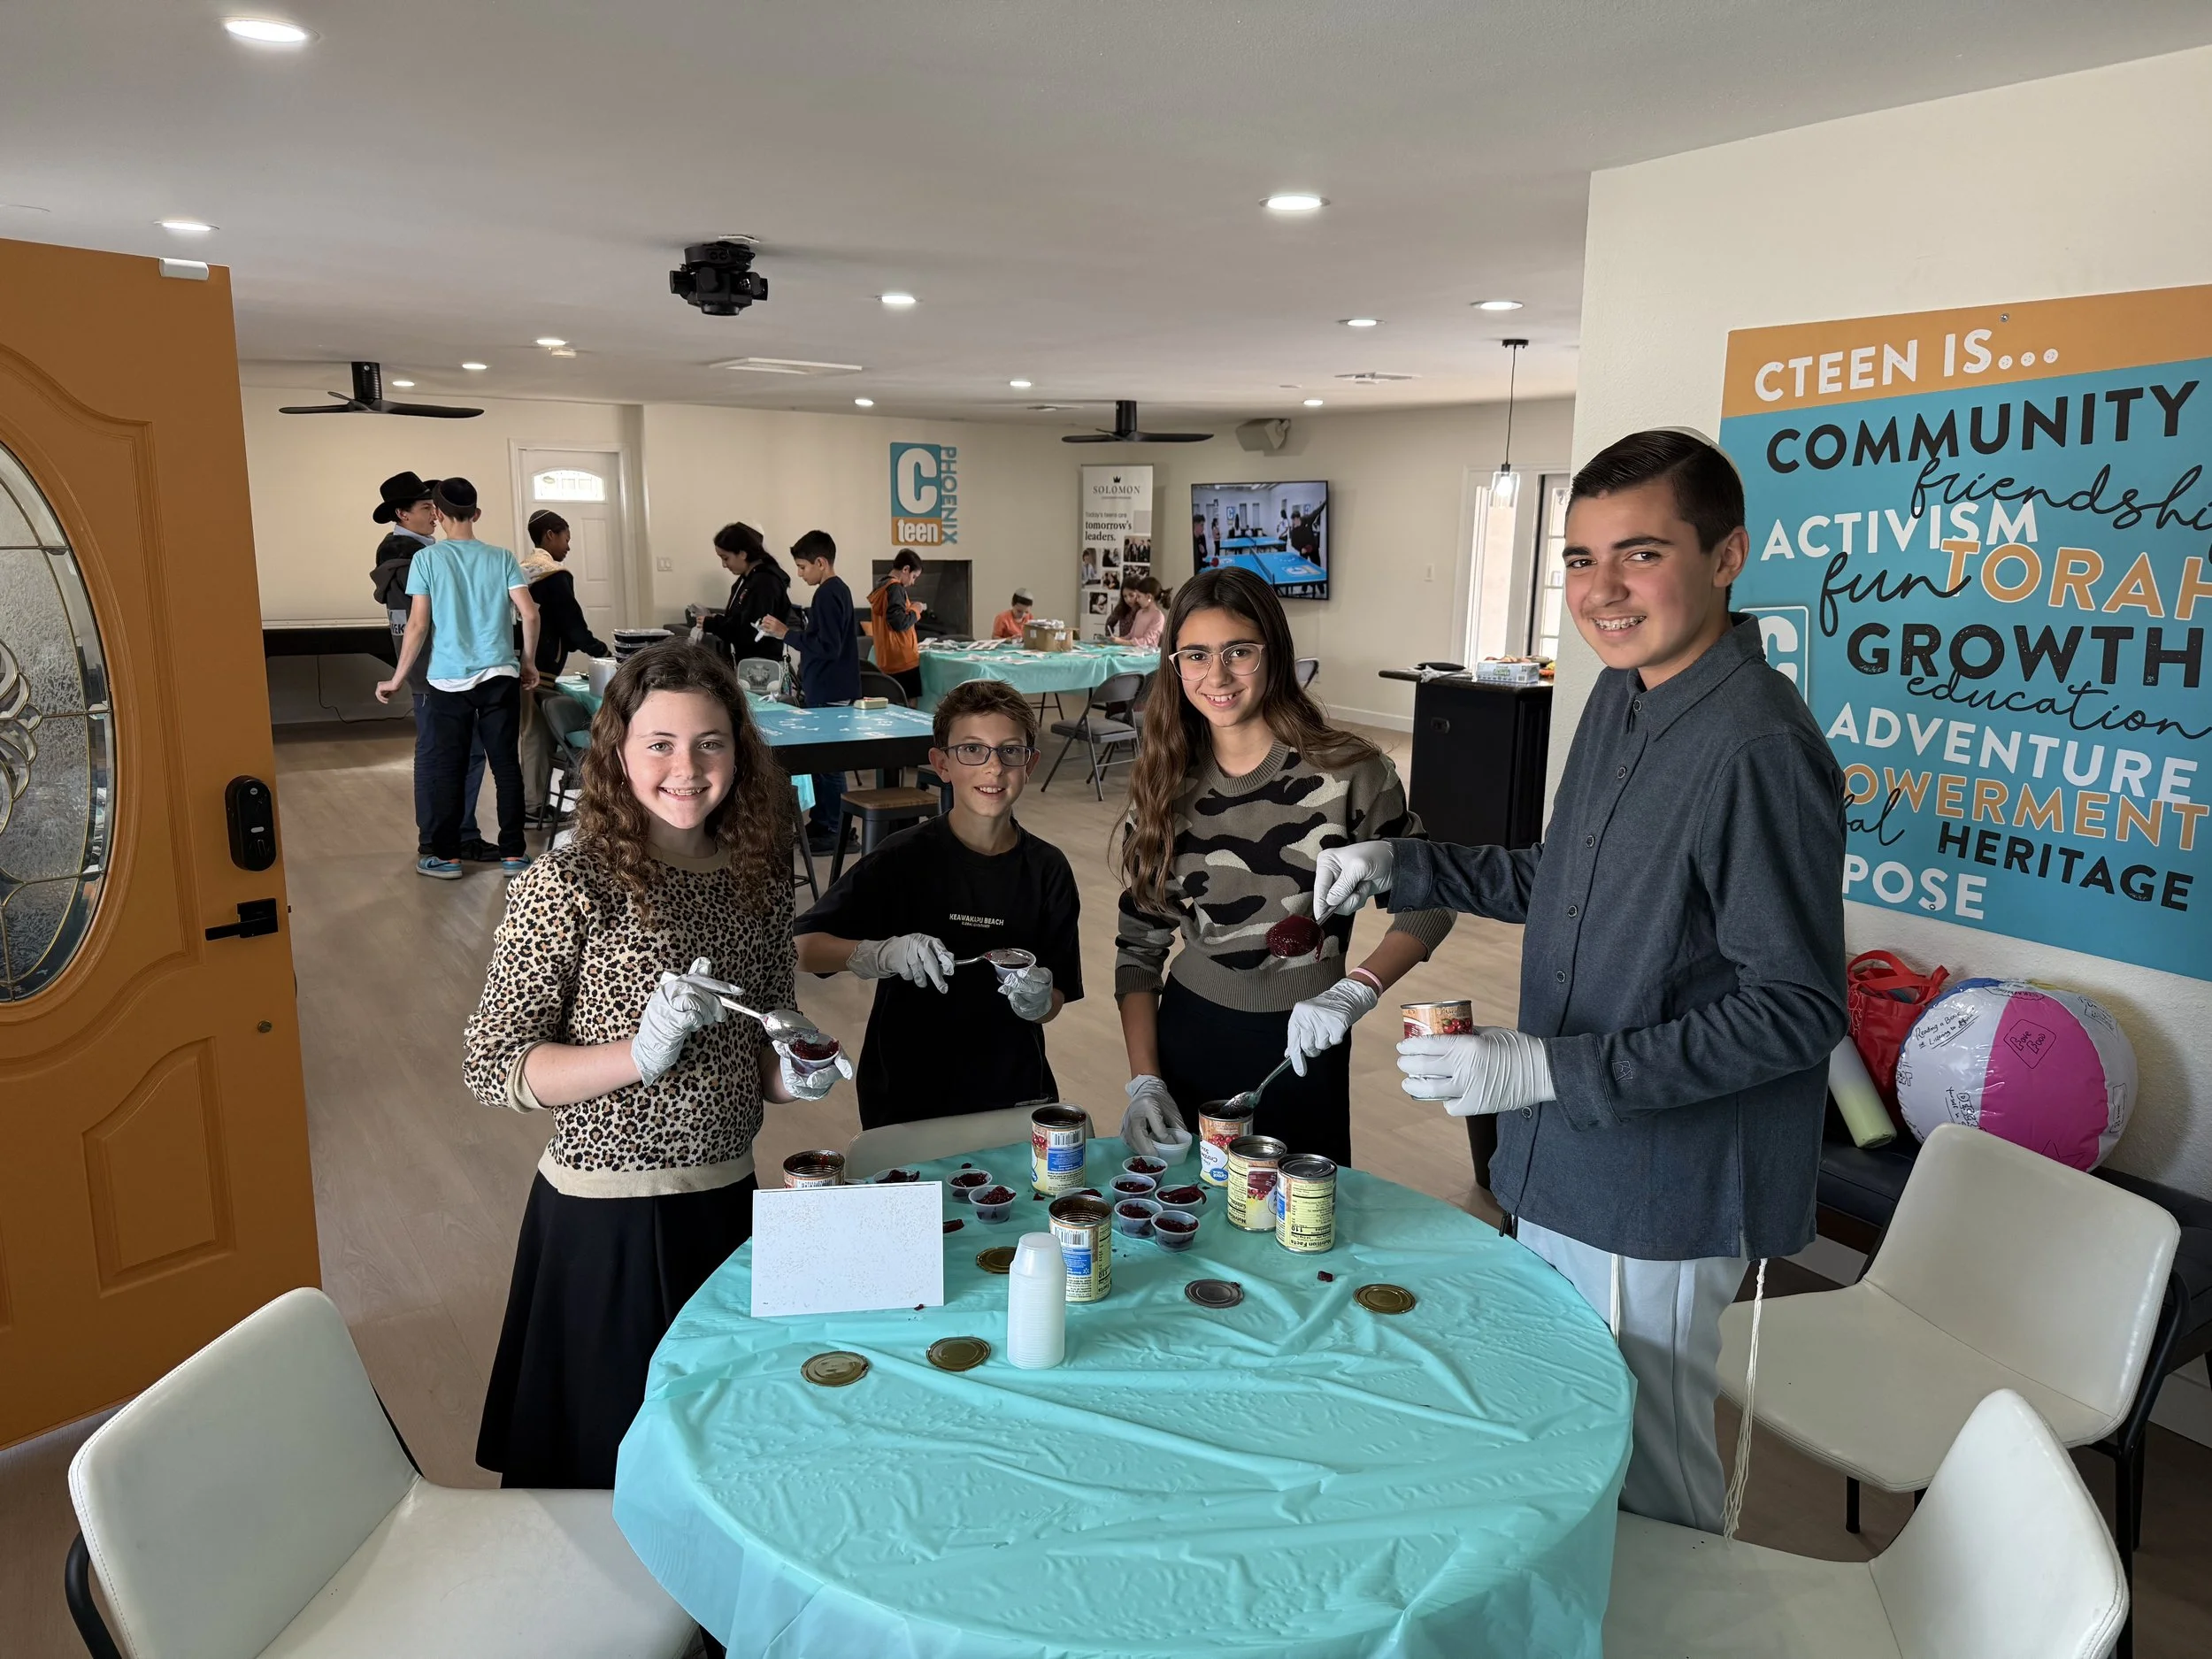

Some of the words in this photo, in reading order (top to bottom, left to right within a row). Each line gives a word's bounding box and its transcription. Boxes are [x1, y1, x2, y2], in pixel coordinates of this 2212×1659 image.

[1755, 339, 1917, 402] CTEEN
[1944, 329, 2059, 377] IS...
[1766, 380, 2200, 473] COMMUNITY
[897, 448, 938, 514] C
[941, 446, 957, 544] PHOENIX
[1093, 486, 1141, 495] SOLOMON
[1911, 457, 2212, 565] friendshi
[897, 518, 939, 543] teen
[1085, 520, 1132, 530] tomorrow's
[1085, 531, 1116, 541] leaders.
[1761, 498, 2039, 561] ACTIVISM
[1819, 551, 1971, 637] fun
[1940, 538, 2212, 621] TORAH
[1847, 622, 2204, 688] GROWTH
[1906, 671, 2212, 741] education
[1826, 703, 2199, 803] ADVENTURE
[1844, 787, 1905, 847] al
[1937, 821, 2194, 912] HERITAGE
[984, 917, 1004, 926] BEACH
[1915, 1023, 1939, 1041] Reading
[1309, 1239, 1332, 1248] Nutrition
